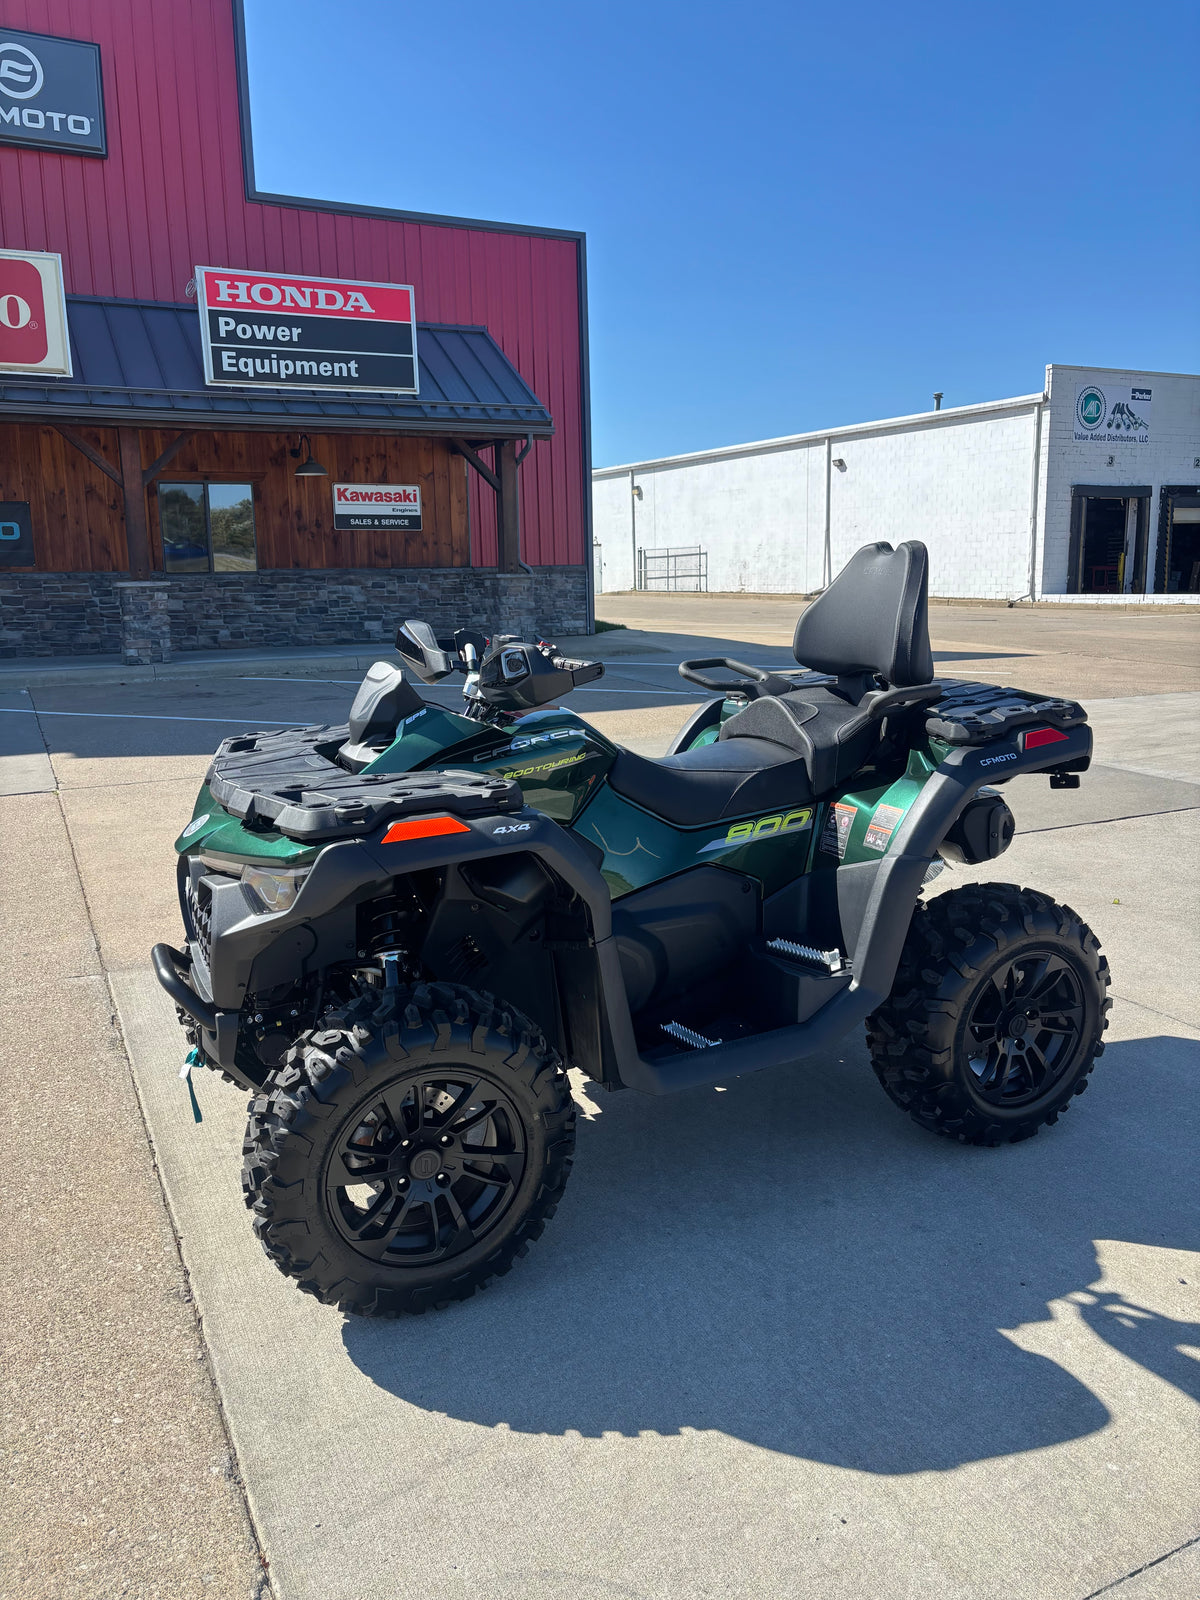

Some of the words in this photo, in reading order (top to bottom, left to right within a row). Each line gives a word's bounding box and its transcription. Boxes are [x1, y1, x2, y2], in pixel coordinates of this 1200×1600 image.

[215, 280, 376, 313] HONDA
[218, 317, 302, 342] Power
[221, 351, 359, 378] Equipment
[1074, 431, 1089, 441] Value
[1090, 433, 1106, 441] Added
[1138, 435, 1149, 443] LLC
[1108, 456, 1114, 465] 3
[336, 488, 418, 503] Kawasaki
[405, 708, 427, 725] EPS
[503, 766, 535, 780] 800
[535, 752, 587, 771] TOURING
[979, 752, 1018, 767] CFMOTO
[725, 807, 814, 844] 800
